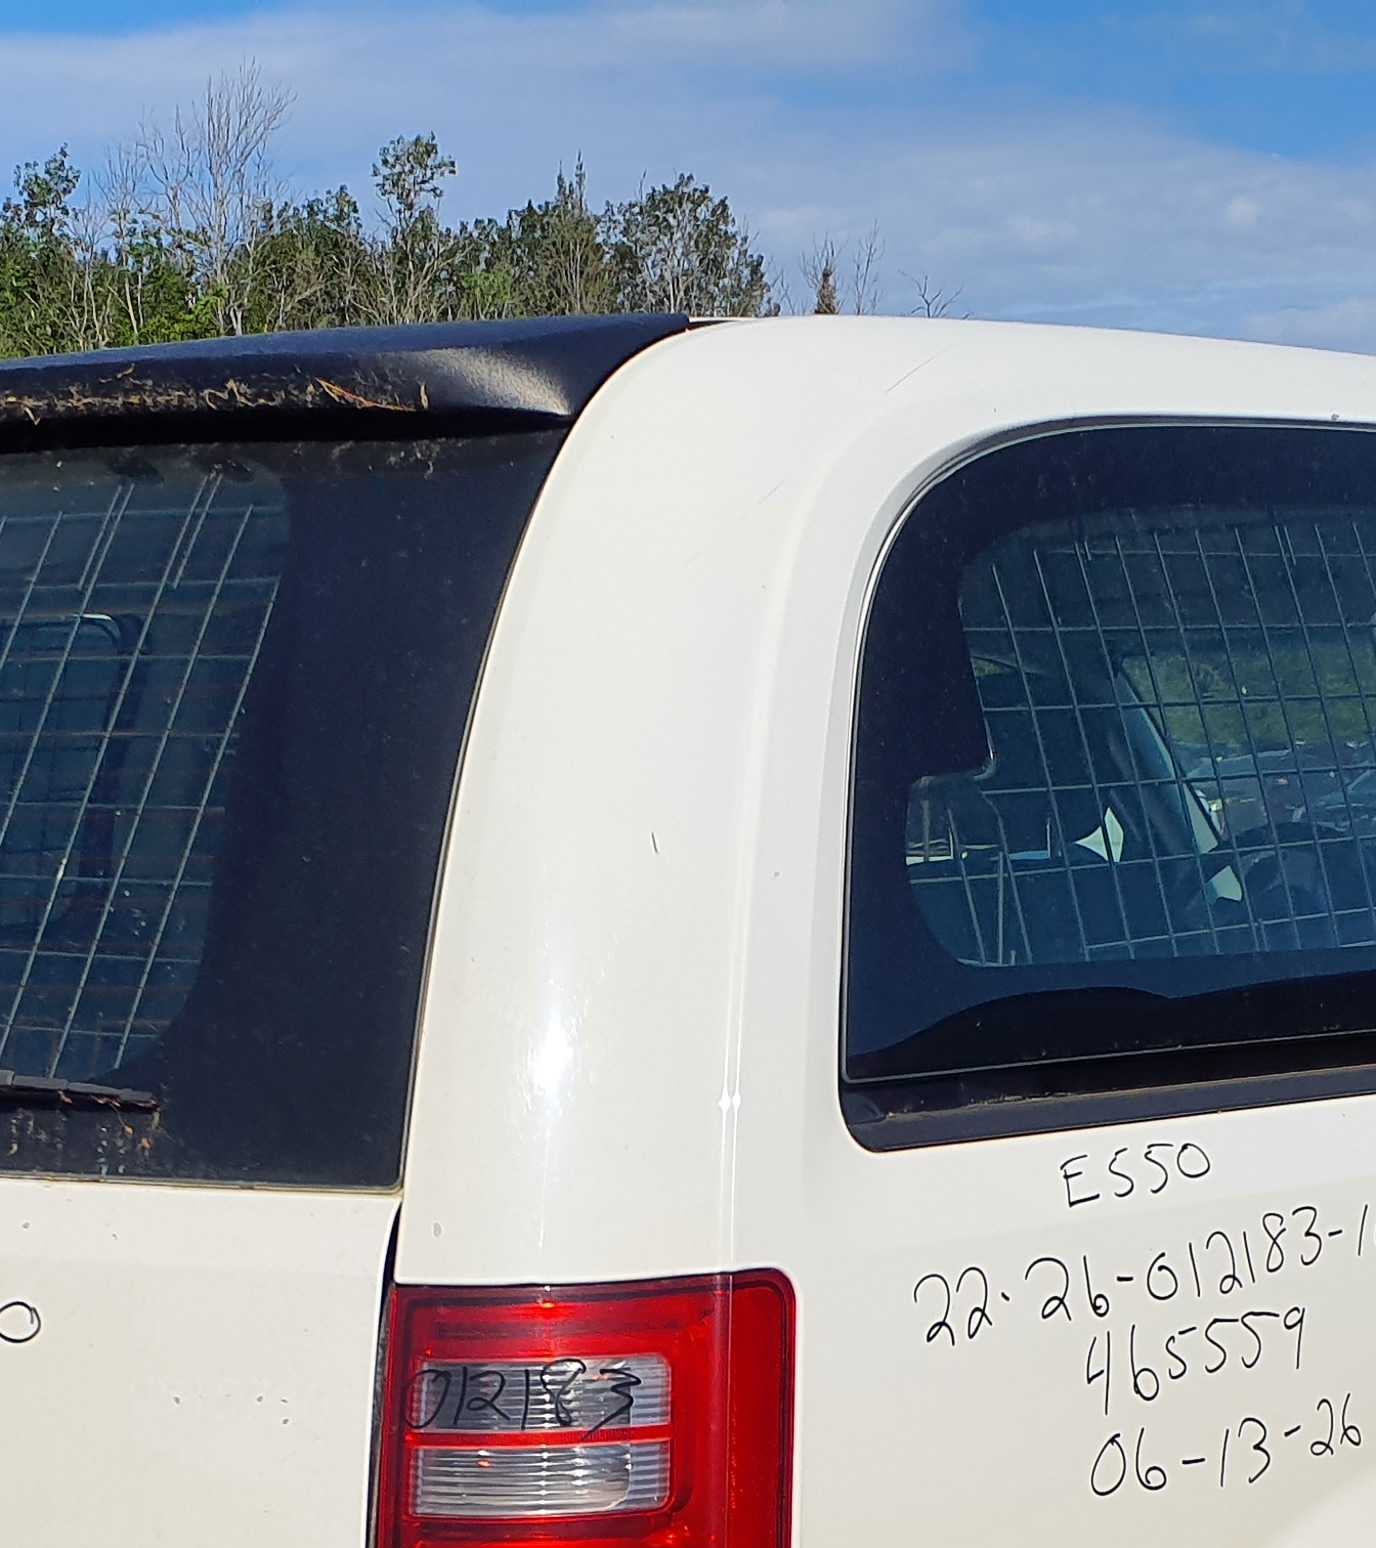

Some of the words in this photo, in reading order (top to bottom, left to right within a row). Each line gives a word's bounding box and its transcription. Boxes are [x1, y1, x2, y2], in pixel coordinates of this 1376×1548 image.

[405, 1358, 642, 1441] 012183
[1086, 1306, 1306, 1415] 465559
[1089, 1393, 1362, 1496] 06-13-26
